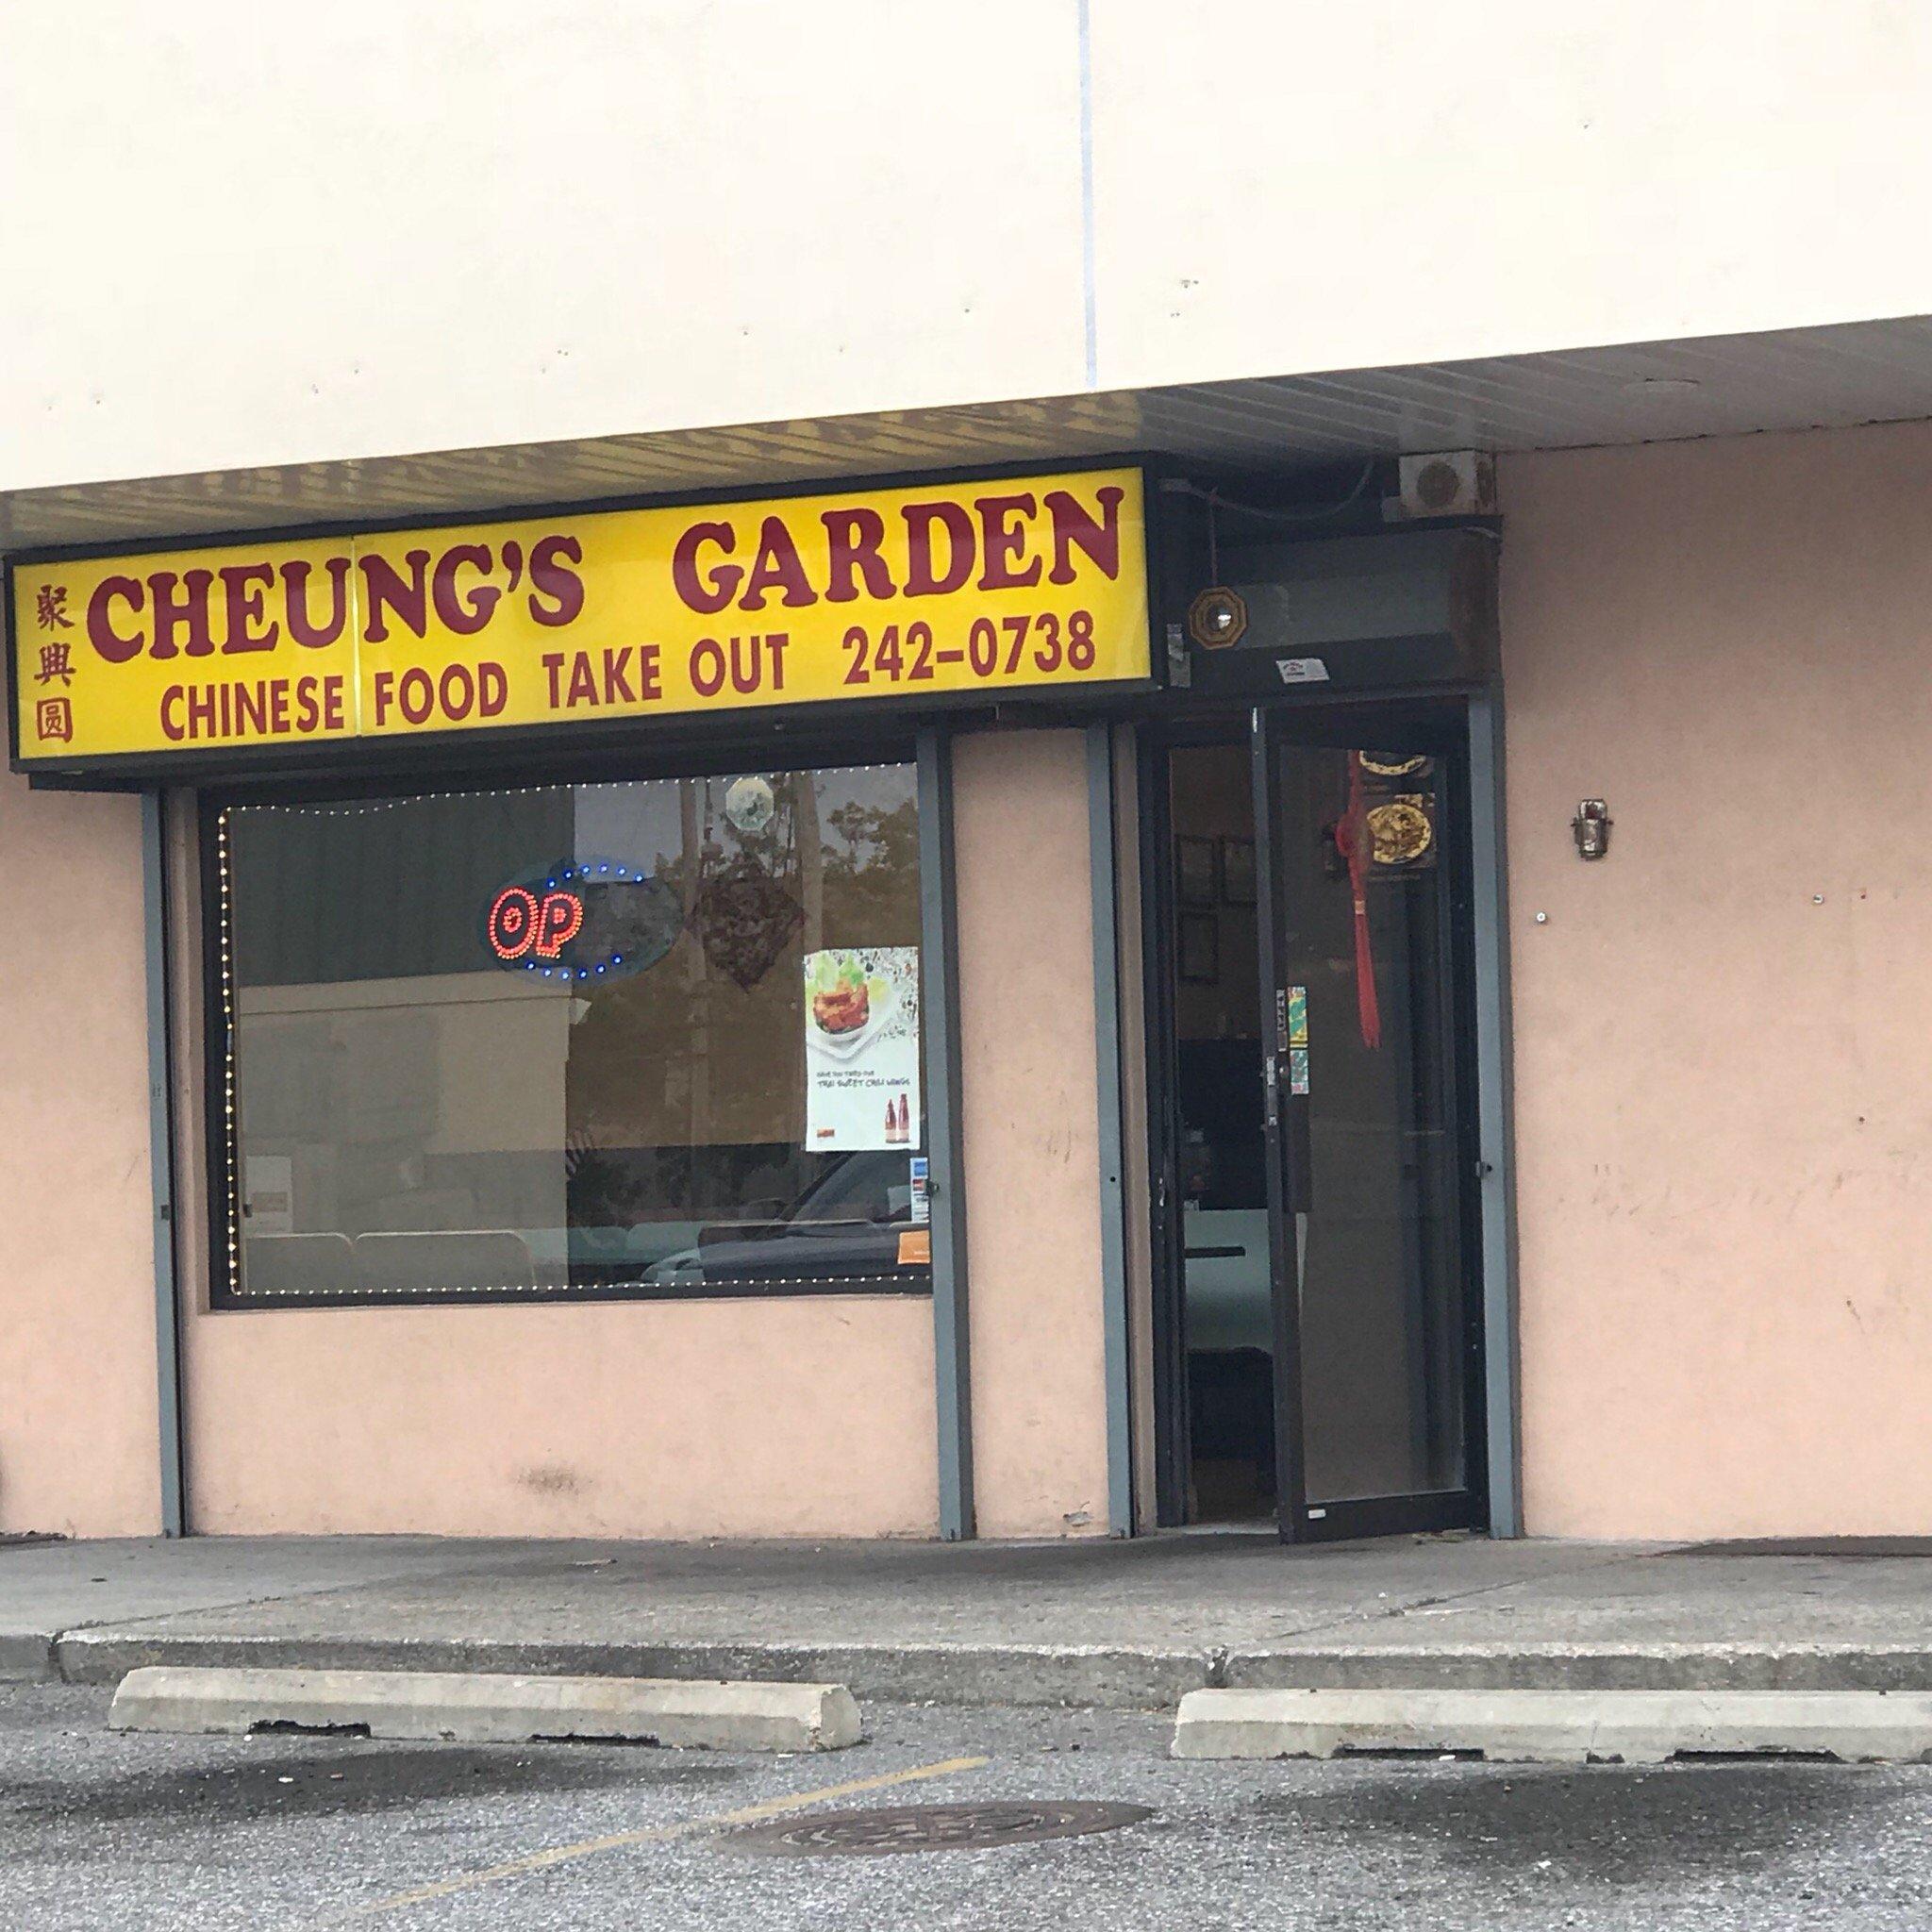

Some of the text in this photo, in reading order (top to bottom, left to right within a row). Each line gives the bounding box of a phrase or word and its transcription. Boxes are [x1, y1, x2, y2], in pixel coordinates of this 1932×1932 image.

[86, 486, 1124, 664] CHEUNG'S GARDEN
[159, 609, 1096, 741] CHINESE FOOD TAKE OUT 242-0738
